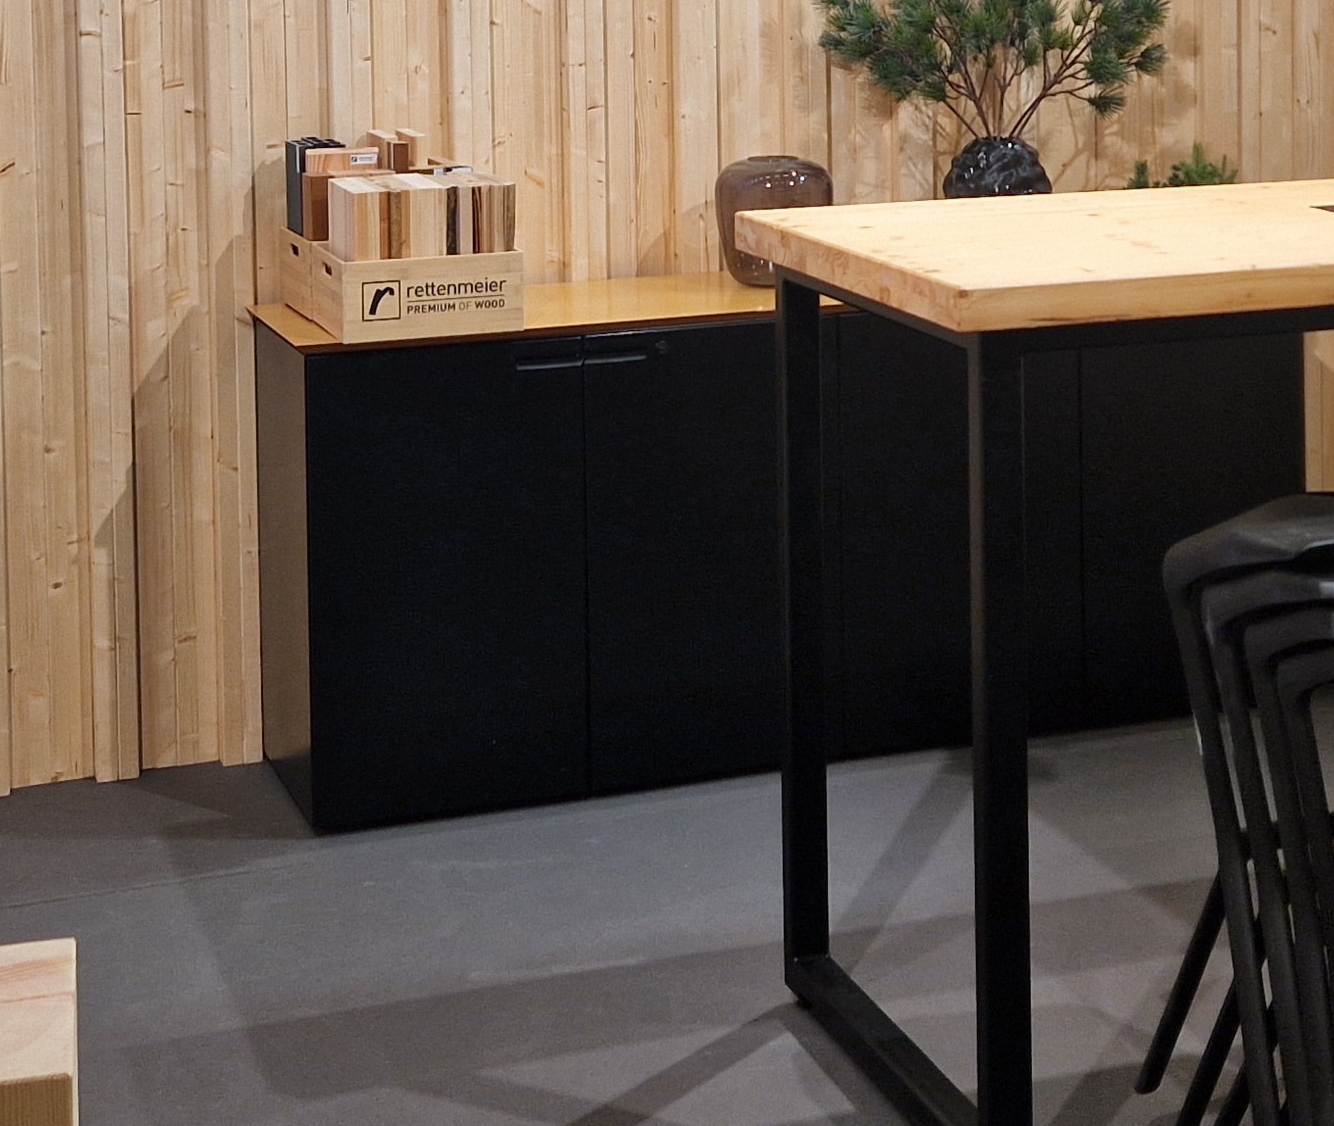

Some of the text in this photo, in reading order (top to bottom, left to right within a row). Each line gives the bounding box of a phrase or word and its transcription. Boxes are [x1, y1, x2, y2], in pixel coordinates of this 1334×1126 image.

[406, 276, 507, 299] rettenmeier
[406, 298, 506, 315] PREMIUM OF WOOD
